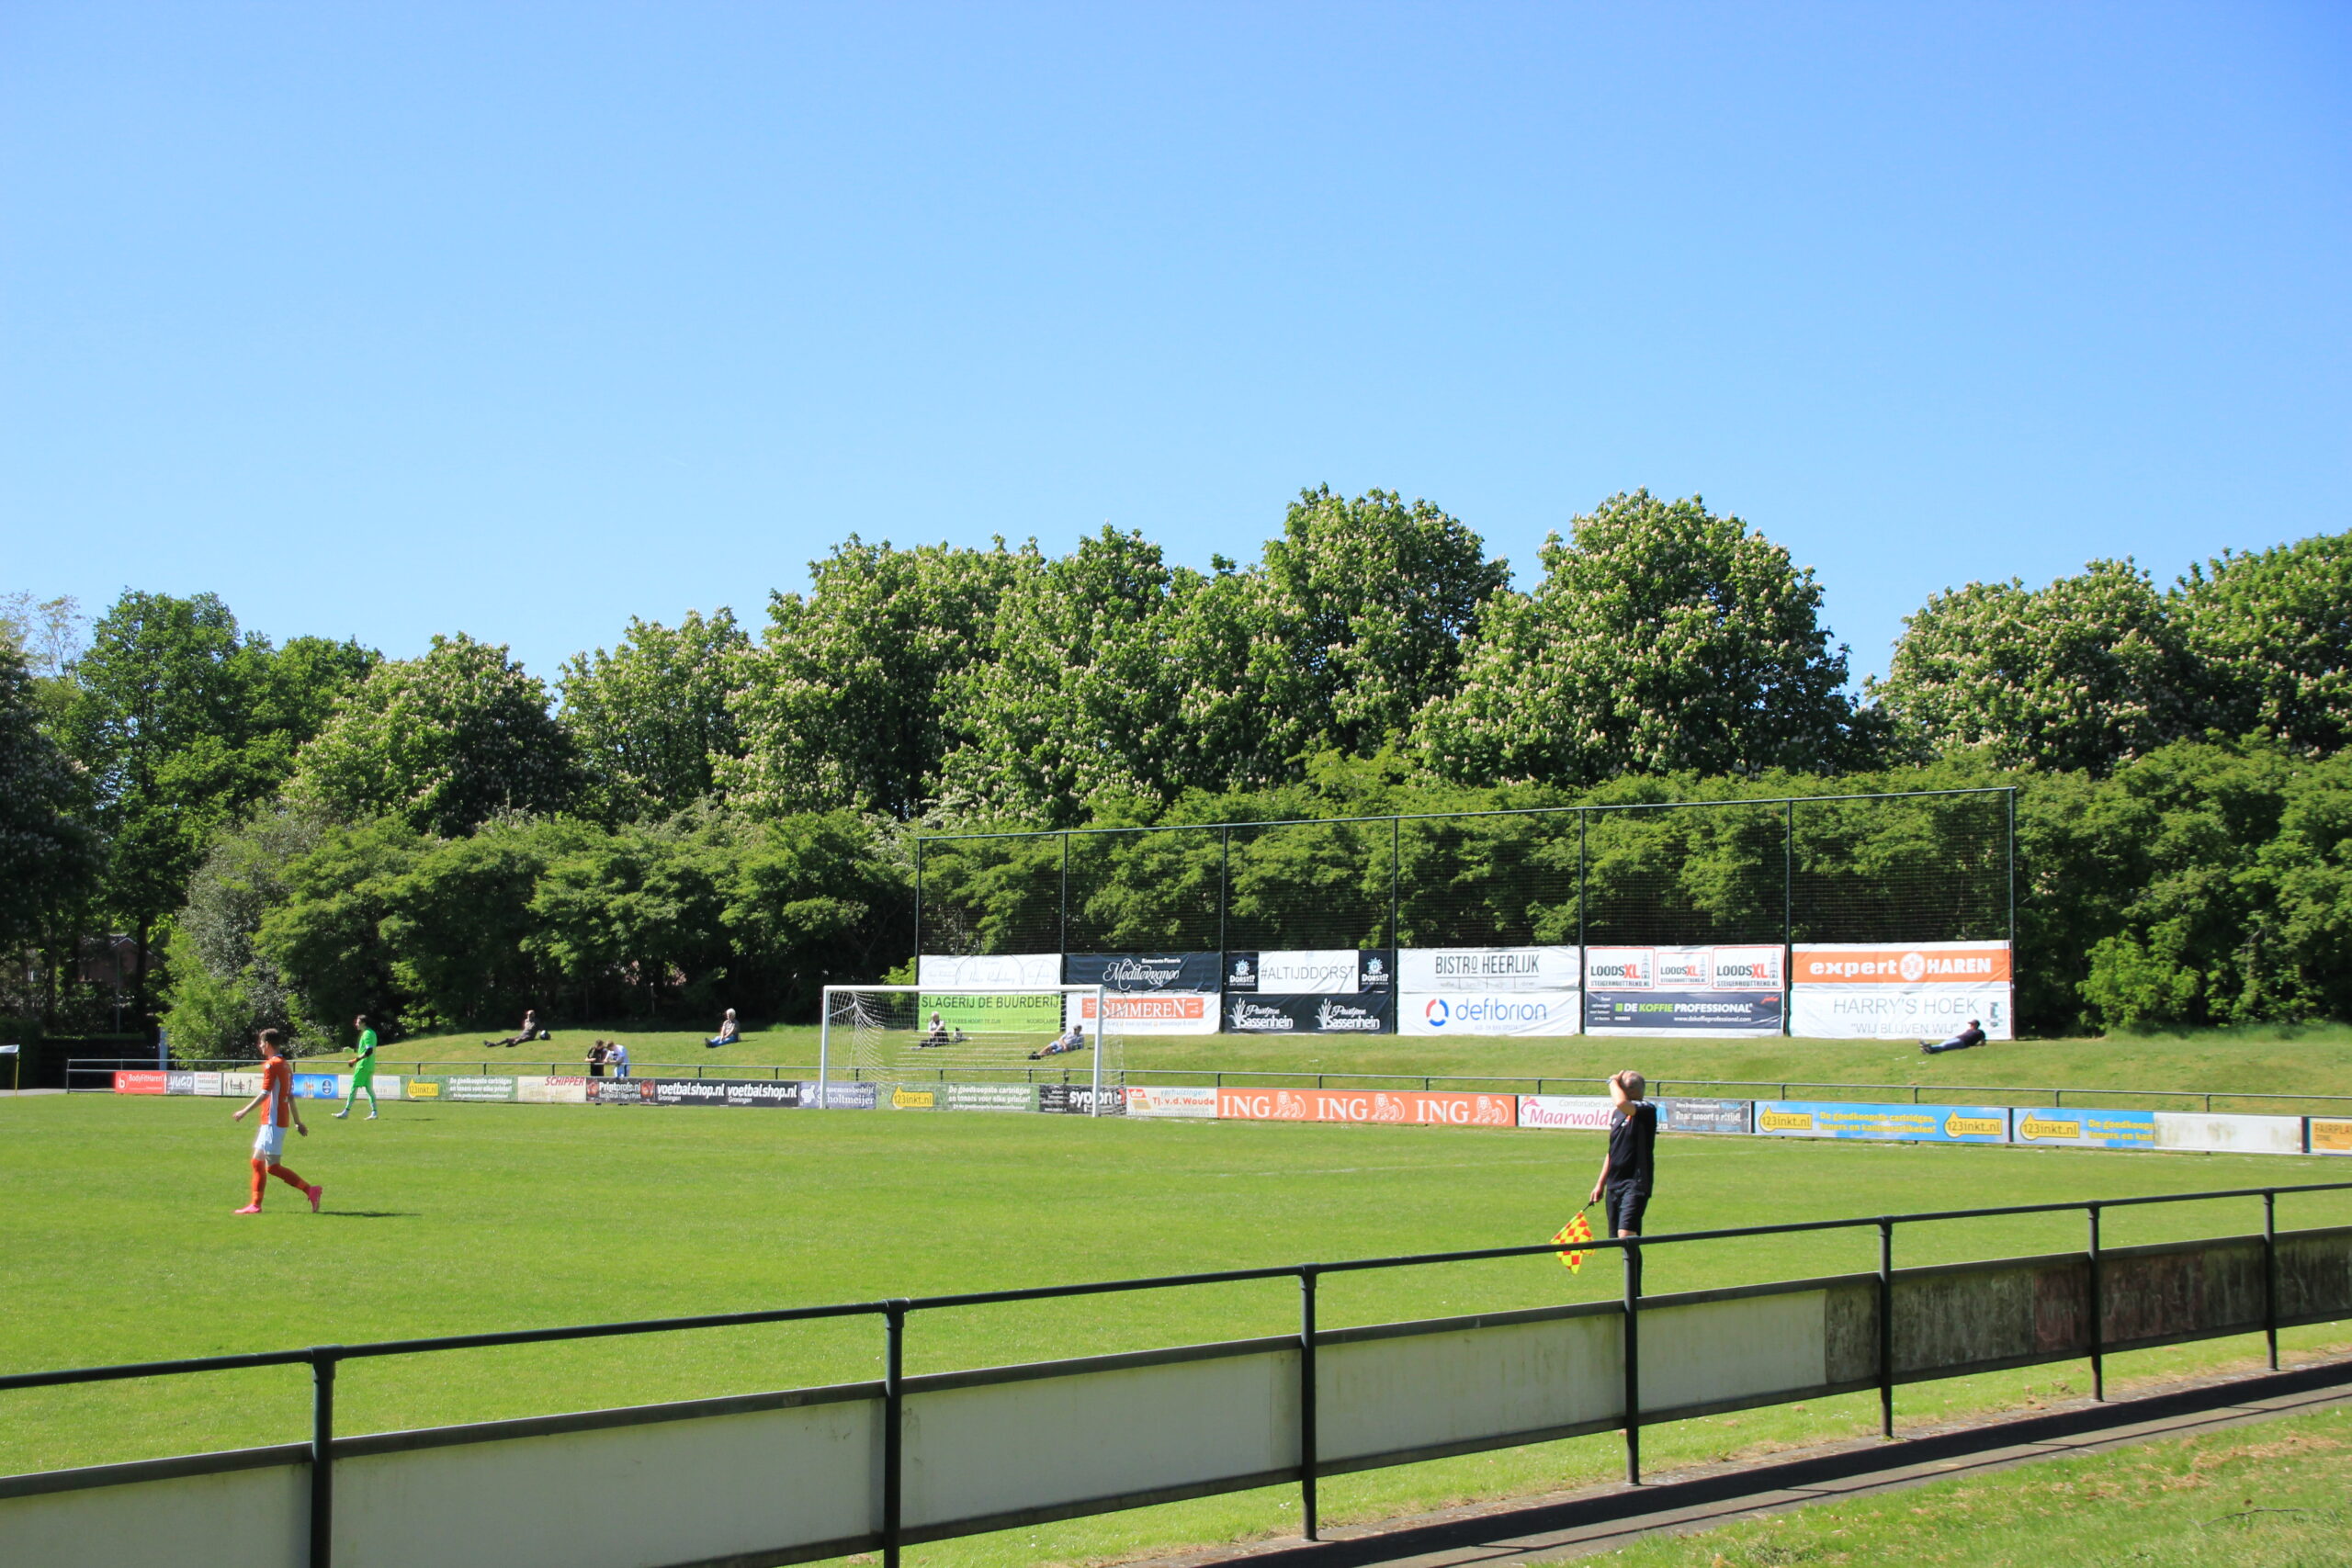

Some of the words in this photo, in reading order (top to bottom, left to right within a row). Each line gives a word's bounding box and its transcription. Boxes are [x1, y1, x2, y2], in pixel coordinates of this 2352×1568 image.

[1482, 954, 1540, 974] HEERLIJK
[1590, 964, 1640, 978] LOODSXL
[1660, 965, 1699, 976] LOODSXL
[1716, 964, 1769, 978] LOODSXL
[1809, 958, 1897, 977] expert
[1927, 958, 1991, 974] HAREN
[1260, 965, 1356, 980] #ALTIJDDORST
[922, 997, 974, 1008] SLAGERIJ
[978, 997, 993, 1008] DE
[996, 997, 1058, 1008] BUURDERIJ
[1102, 998, 1186, 1018] SIMMEREN
[1455, 998, 1547, 1021] defibrion
[1623, 1003, 1638, 1012] DE
[1639, 1003, 1673, 1012] KOFFIE
[1834, 998, 1917, 1015] HARRY'S
[1924, 998, 1979, 1014] HOEK
[1241, 1015, 1293, 1029] Sassenhein
[1328, 1015, 1380, 1029] Sassenhein
[1880, 1023, 1929, 1034] BLIJVEN
[545, 1077, 585, 1086] SCHIPPER
[598, 1081, 641, 1092] Printprofs.nl
[409, 1084, 438, 1094] 123inkt.nl
[658, 1082, 724, 1099] voetbalshop.nl
[728, 1084, 797, 1100] voetbalshop.nl
[817, 1094, 875, 1106] Sholtmeijer
[895, 1094, 932, 1105] 123inkt.nl
[1183, 1097, 1215, 1106] Woude
[1221, 1095, 1271, 1117] ING
[1317, 1097, 1368, 1121] ING
[1416, 1100, 1470, 1123] ING
[1763, 1115, 1810, 1127] 123inkt.nl
[1947, 1121, 2000, 1133] 123inkt.nl
[2023, 1123, 2077, 1135] 123inkt.nl
